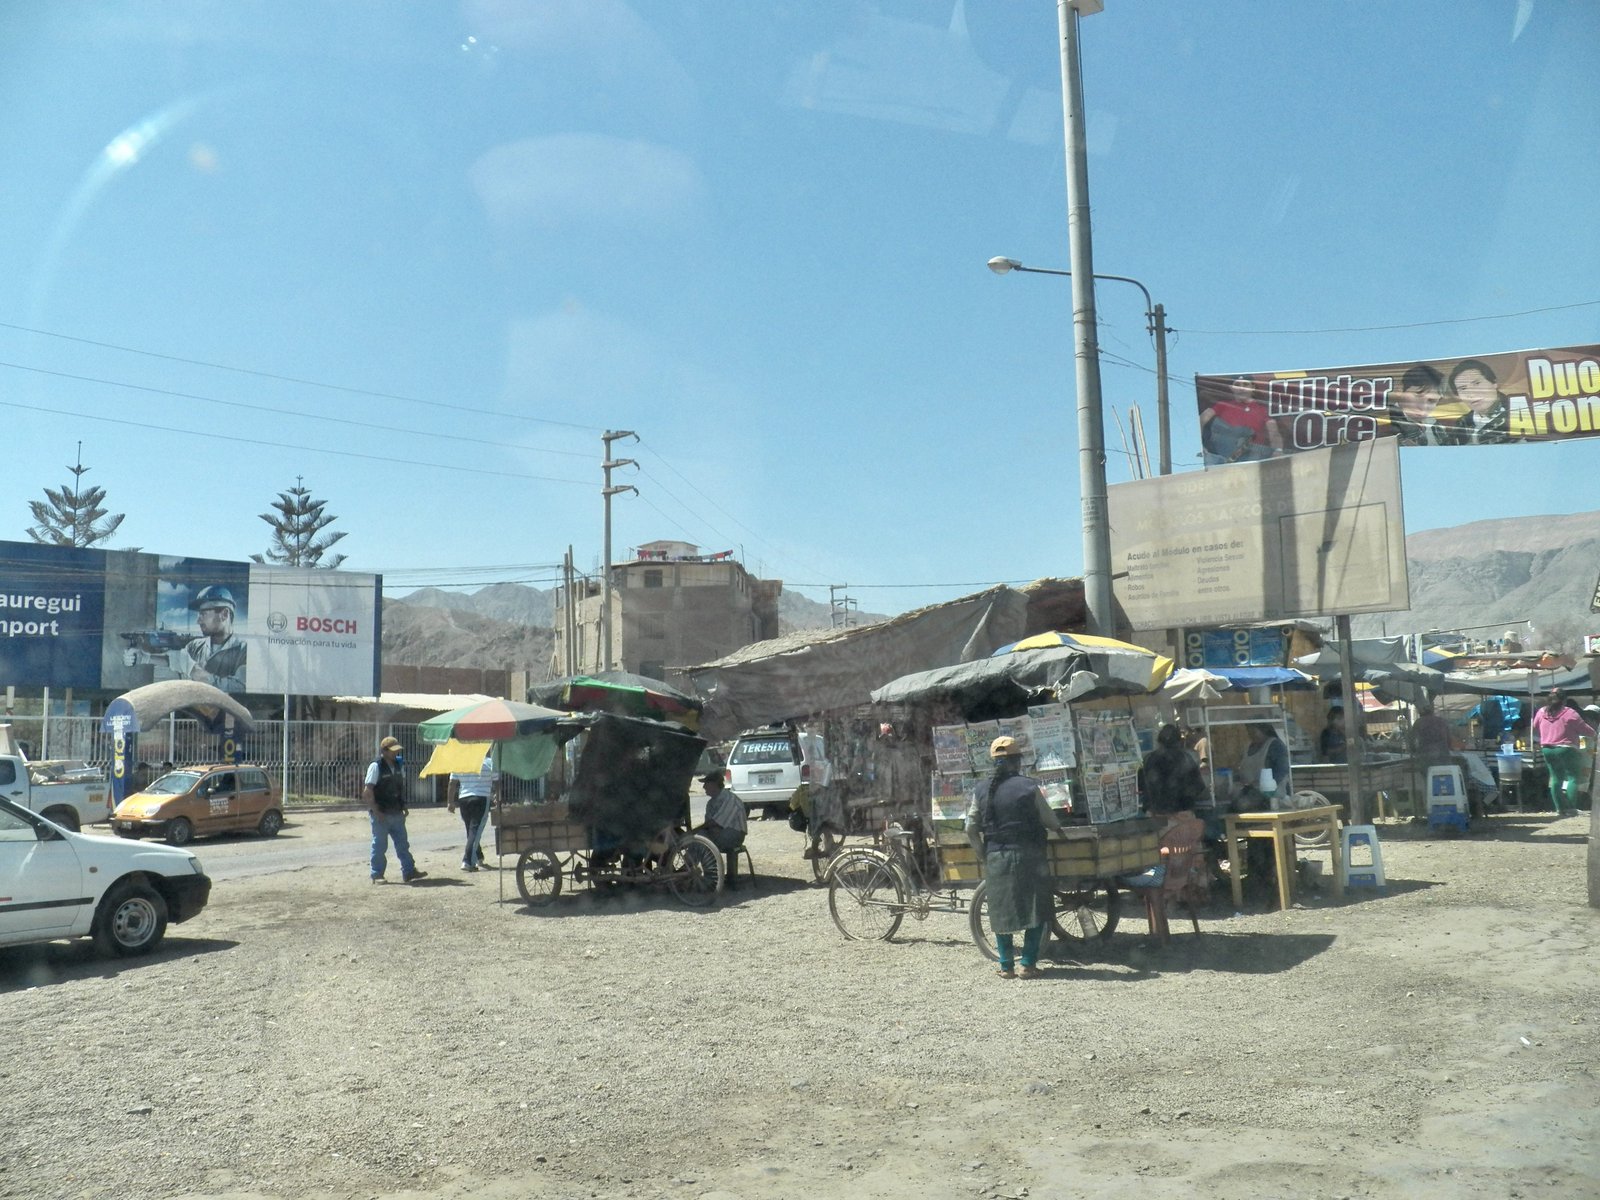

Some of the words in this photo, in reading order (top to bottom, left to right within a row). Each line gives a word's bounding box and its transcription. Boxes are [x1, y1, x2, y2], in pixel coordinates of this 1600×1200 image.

[1528, 359, 1600, 399] Duo
[1269, 375, 1392, 416] Milder
[1293, 410, 1377, 450] Ore
[1204, 542, 1228, 552] casos
[1127, 583, 1145, 592] Robos
[296, 616, 357, 634] BOSCH
[268, 636, 312, 646] Innovación
[312, 640, 330, 648] para
[331, 640, 340, 648] tu
[340, 641, 357, 649] vida
[1187, 632, 1204, 667] oro
[1233, 630, 1250, 665] oro
[743, 742, 790, 754] TERESITA
